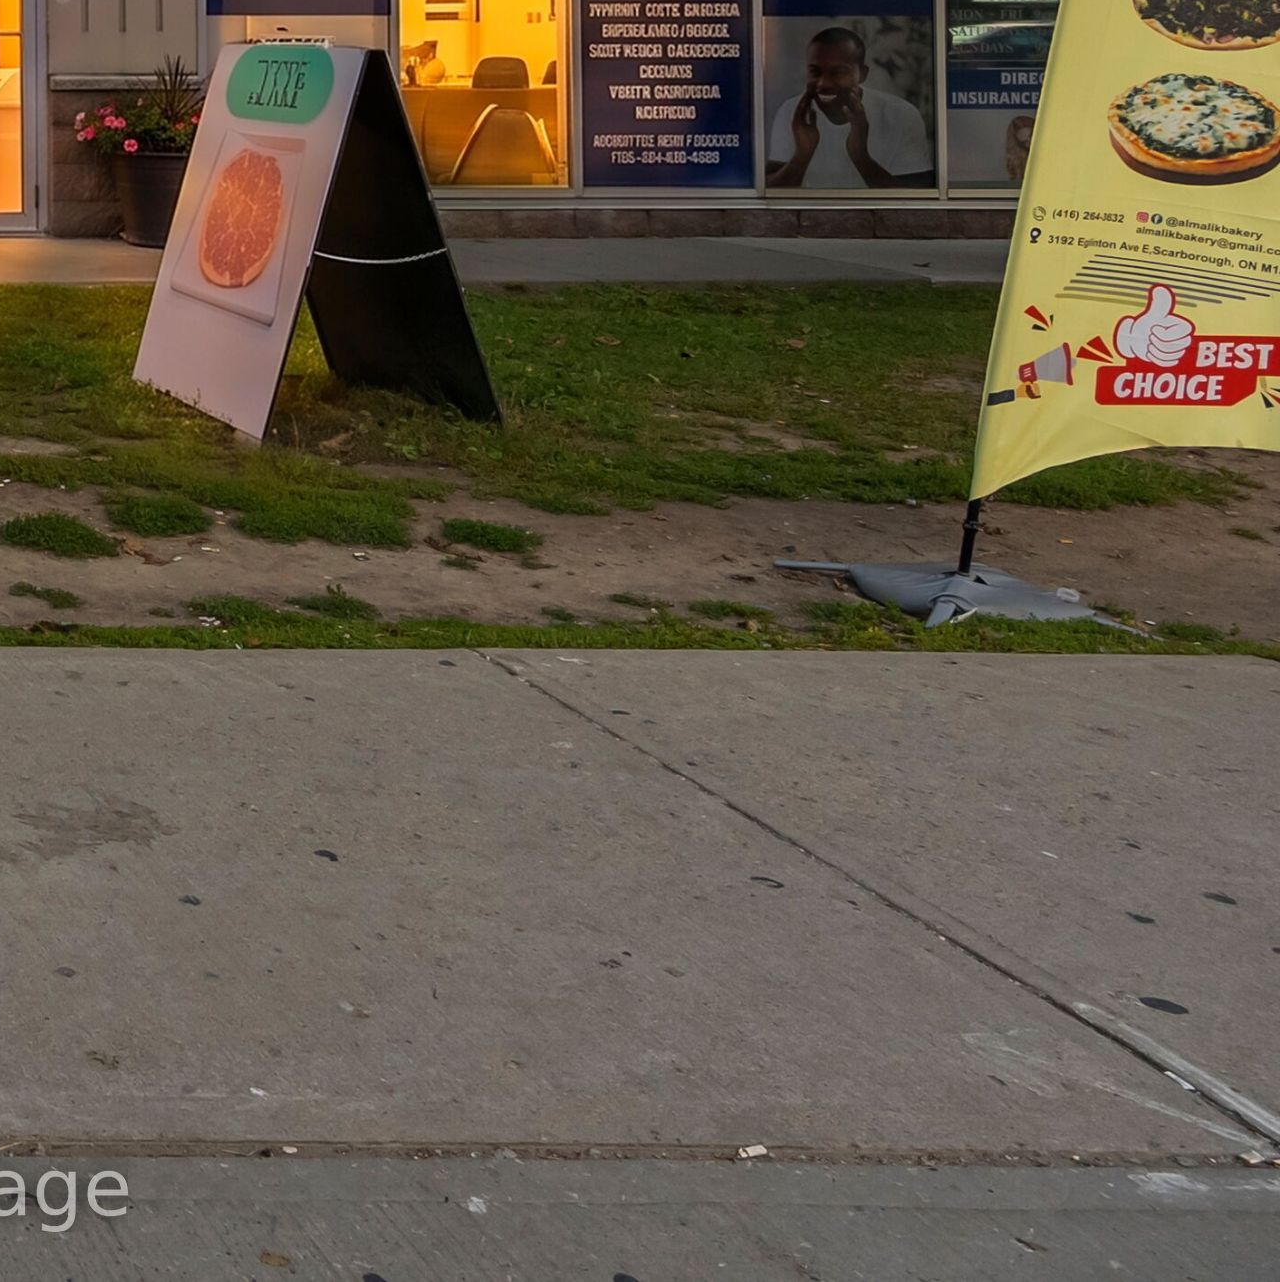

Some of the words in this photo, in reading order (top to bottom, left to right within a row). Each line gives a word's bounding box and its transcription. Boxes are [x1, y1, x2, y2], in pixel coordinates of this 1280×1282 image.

[1165, 216, 1263, 241] @almalikbakery
[1047, 234, 1074, 247] 3192
[1238, 259, 1257, 271] ON
[1195, 341, 1274, 370] BEST
[1113, 372, 1225, 401] CHOICE
